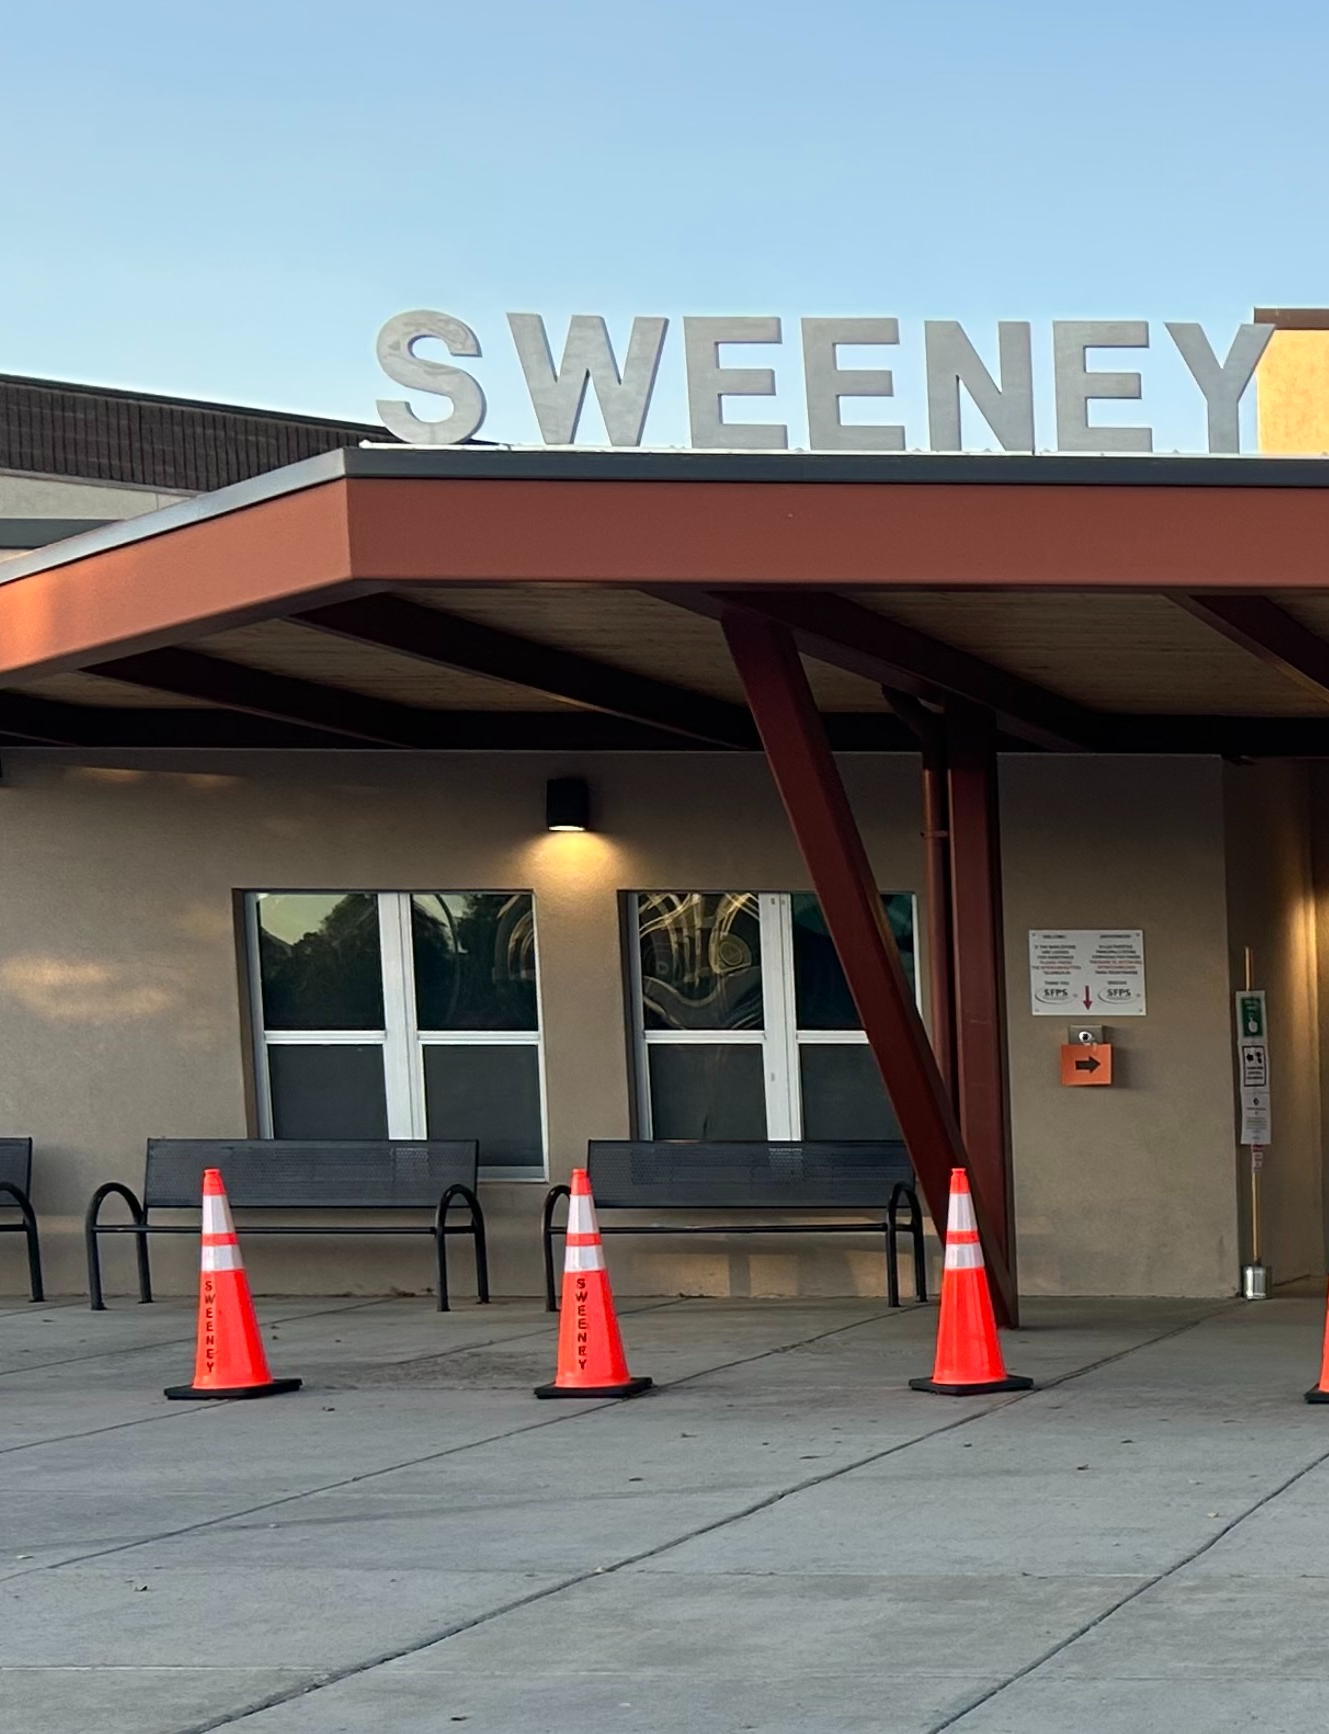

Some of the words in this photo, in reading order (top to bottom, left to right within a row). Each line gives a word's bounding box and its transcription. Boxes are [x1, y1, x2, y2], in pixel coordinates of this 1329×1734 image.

[376, 309, 1276, 453] SWEENEY
[204, 1280, 216, 1373] SWEENEY
[575, 1277, 588, 1371] SWEENEY
